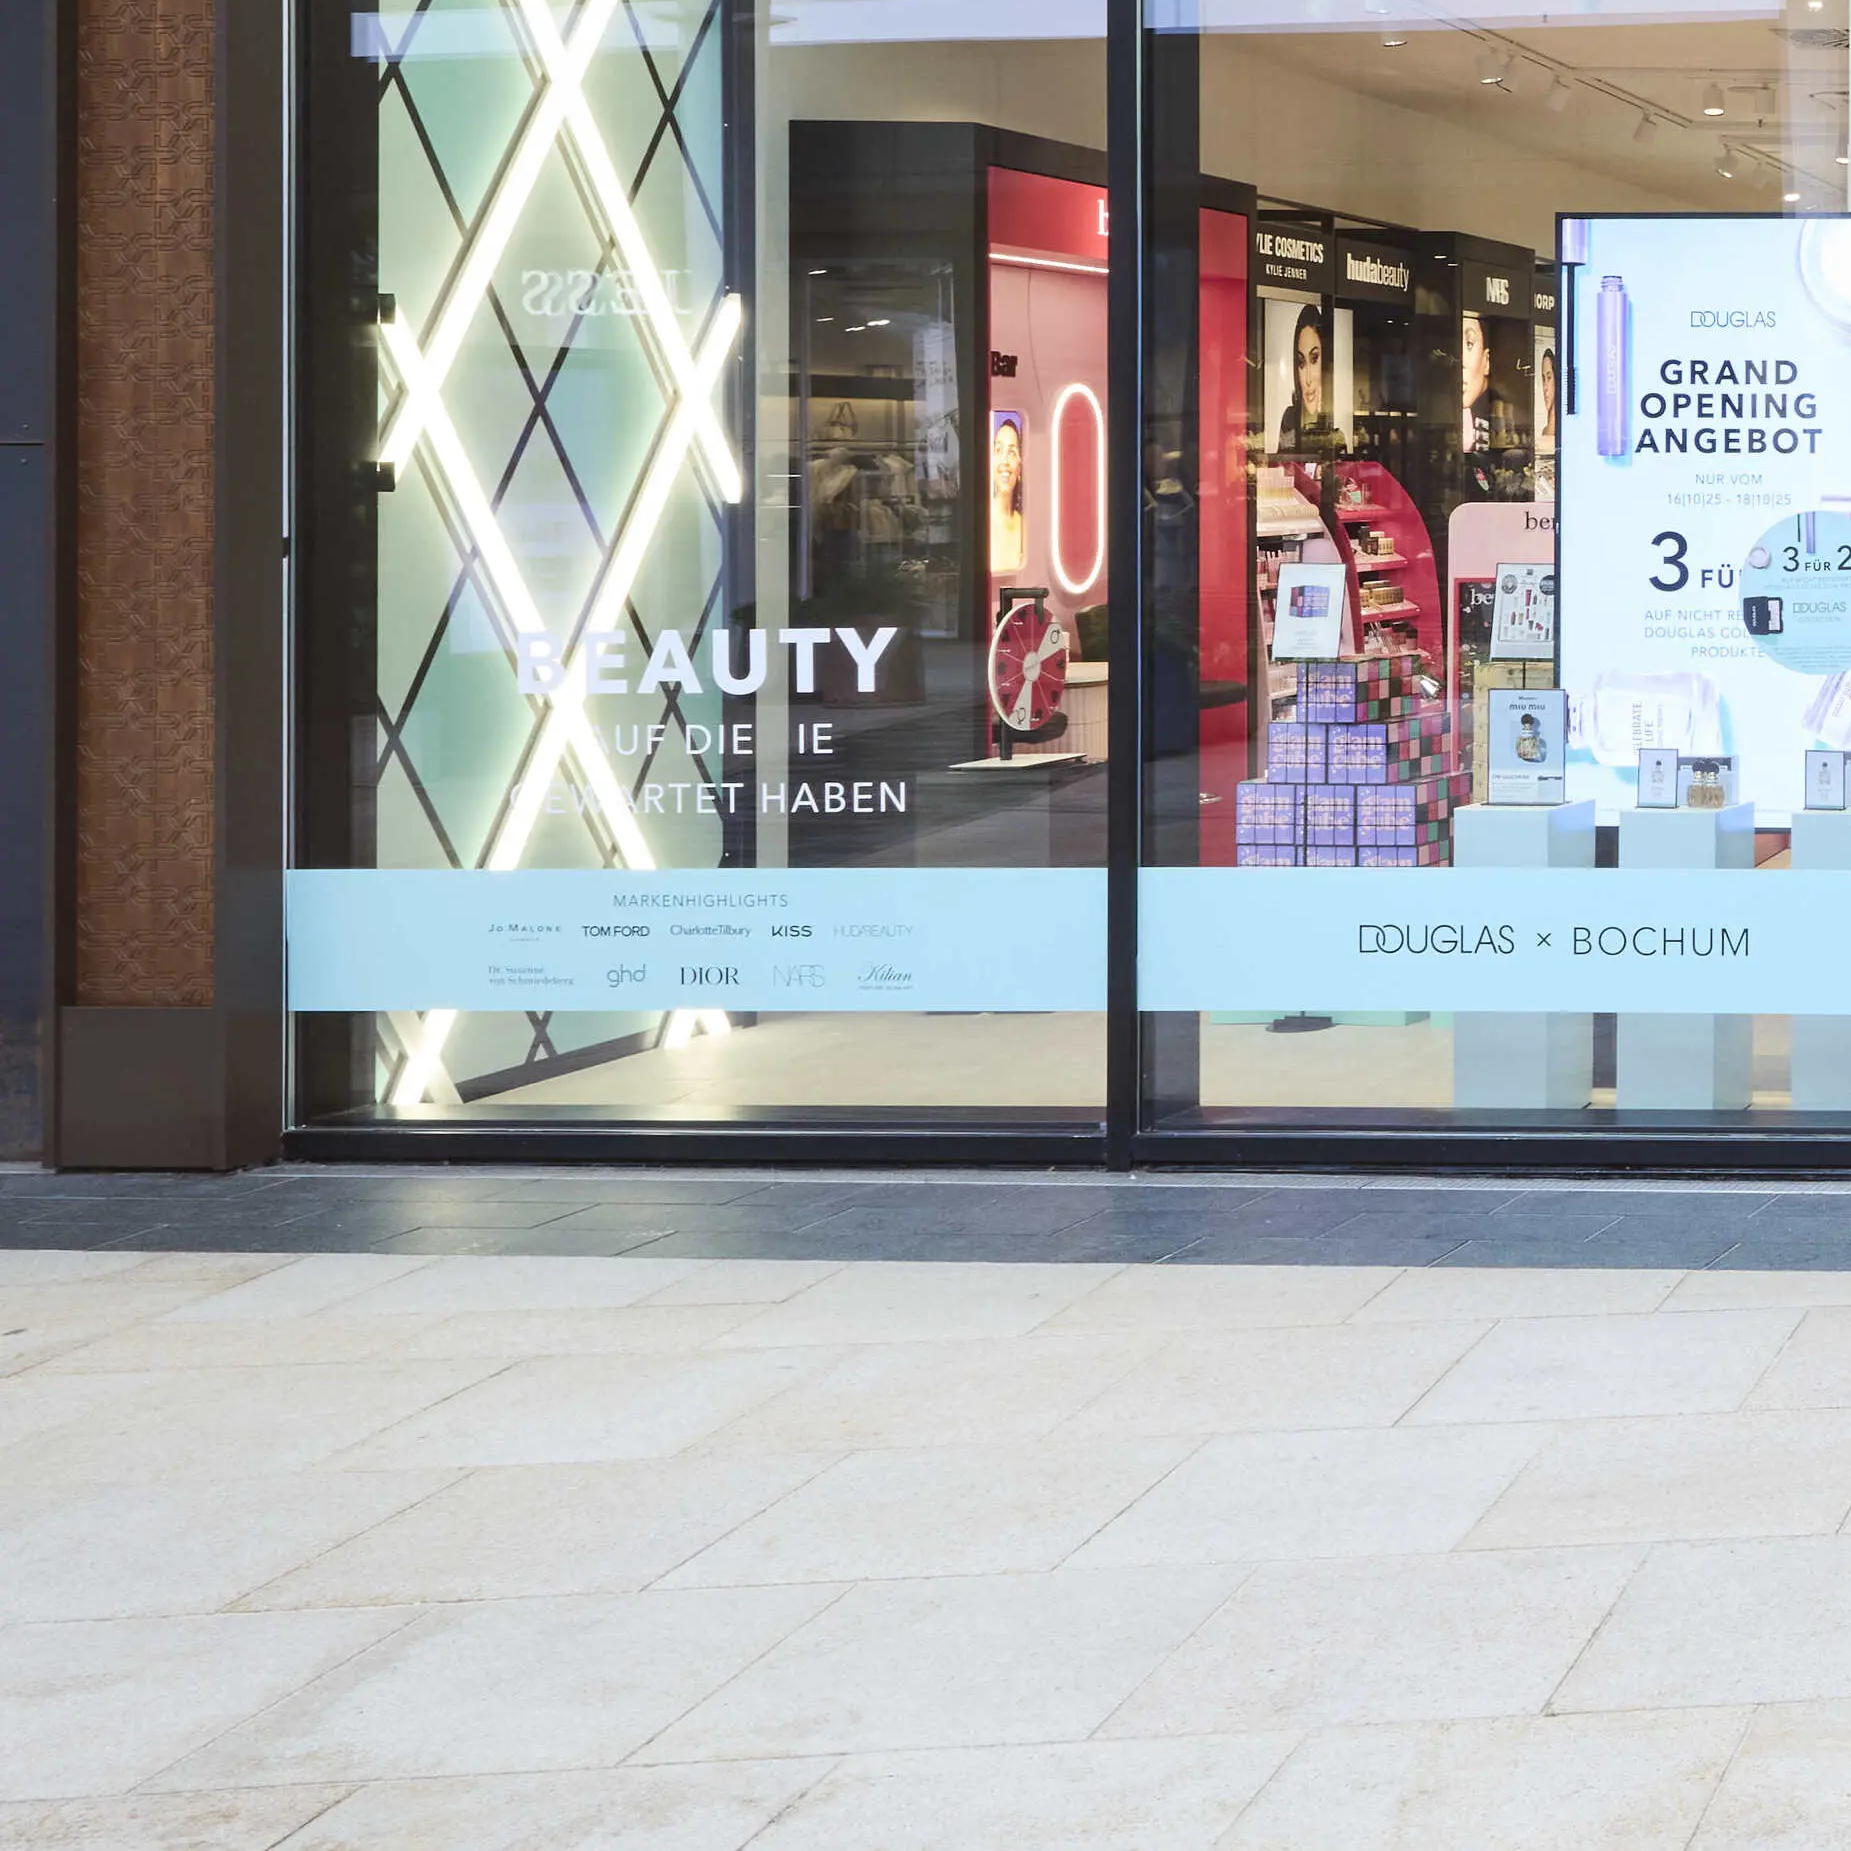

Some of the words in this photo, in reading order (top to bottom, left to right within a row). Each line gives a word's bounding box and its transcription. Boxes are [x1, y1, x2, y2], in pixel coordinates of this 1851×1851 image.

[1275, 235, 1324, 264] COSMETICS
[1265, 263, 1282, 278] KYLIE
[1284, 266, 1307, 281] JENNER
[1346, 252, 1410, 292] hudabeauty
[1534, 293, 1555, 311] ORP
[1690, 310, 1777, 329] DOUGLAS
[990, 351, 1018, 378] Bar
[1659, 359, 1798, 386] GRAND
[1639, 392, 1818, 419] OPENING
[1635, 428, 1823, 454] ANGEBOT
[1695, 474, 1727, 486] NUR
[1731, 474, 1763, 486] VOM
[1648, 530, 1690, 593] 3
[1700, 563, 1742, 589] FÜ
[1782, 545, 1800, 573] 3
[1804, 560, 1831, 572] FÜR
[1792, 601, 1848, 614] DOUGLAS
[1644, 627, 1716, 639] DOUGLAS
[517, 626, 898, 696] BEAUTY
[685, 723, 754, 756] DIE
[761, 780, 907, 814] HABEN
[612, 894, 789, 908] MARKENHIGHLIGHTS
[582, 925, 611, 938] TOM
[613, 925, 651, 938] FORD
[771, 924, 813, 938] KISS
[1358, 923, 1515, 955] DOUGLAS
[1572, 926, 1750, 957] BOCHUM
[606, 963, 646, 988] ghd
[680, 966, 741, 986] DIOR
[857, 962, 913, 983] Kilian
